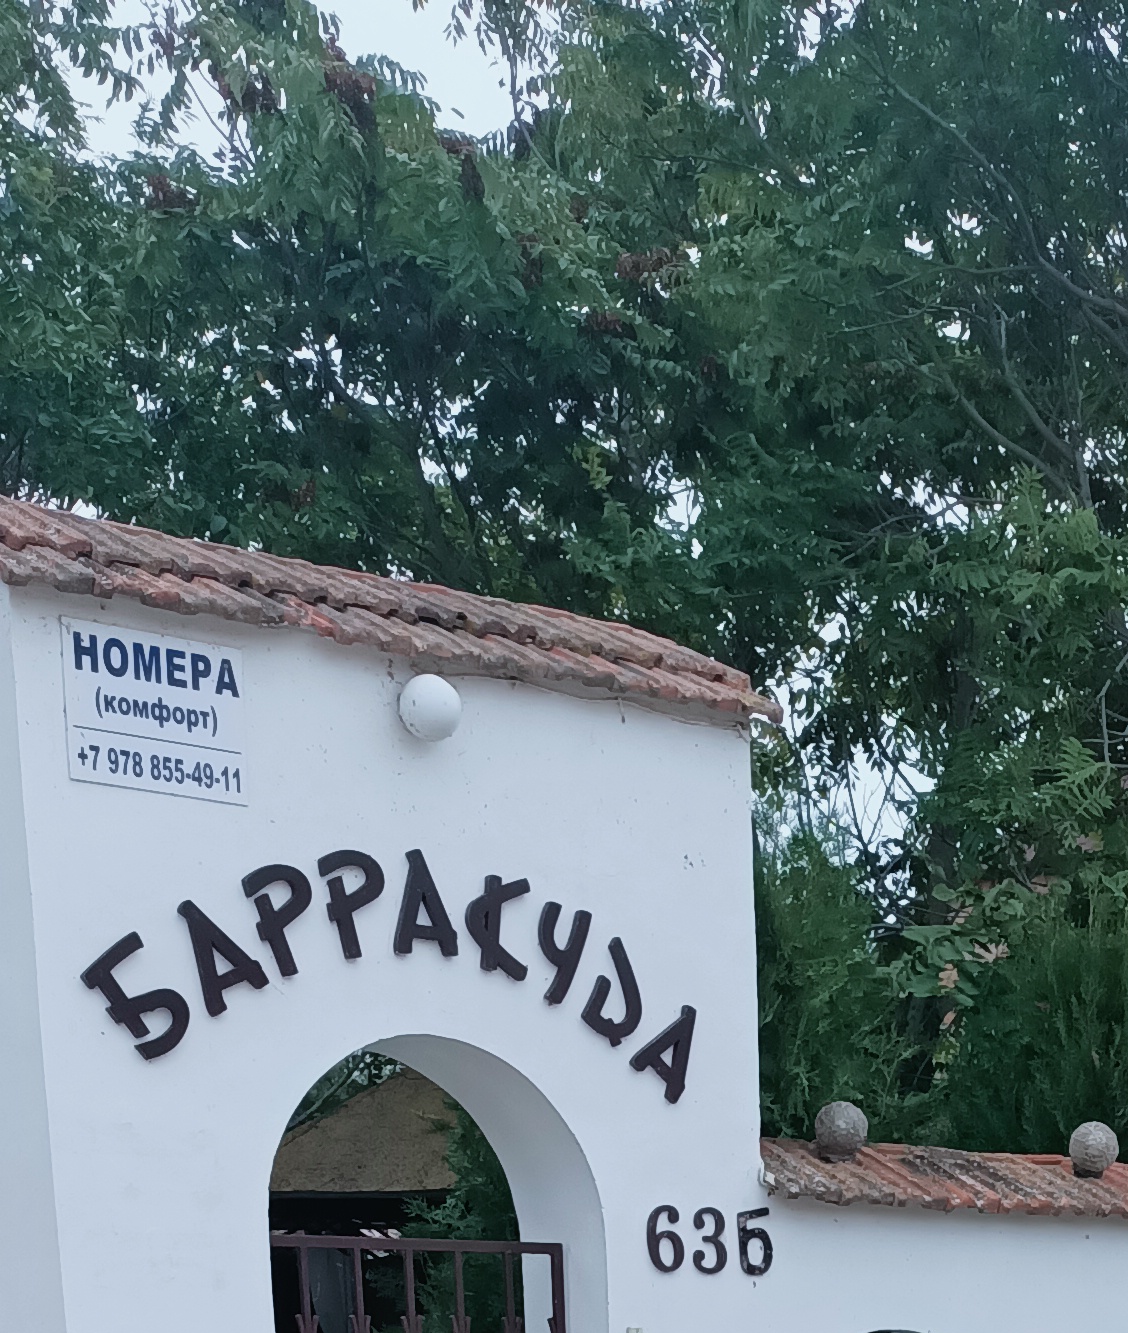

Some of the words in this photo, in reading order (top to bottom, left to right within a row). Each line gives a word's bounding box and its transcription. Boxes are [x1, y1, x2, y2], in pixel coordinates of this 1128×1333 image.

[73, 630, 240, 698] НОМЕРА
[95, 685, 218, 737] (комфорт)
[78, 744, 100, 771] +7
[107, 747, 144, 778] 978
[150, 754, 242, 794] 855-49-11
[80, 849, 697, 1104] БАРРАКУДА
